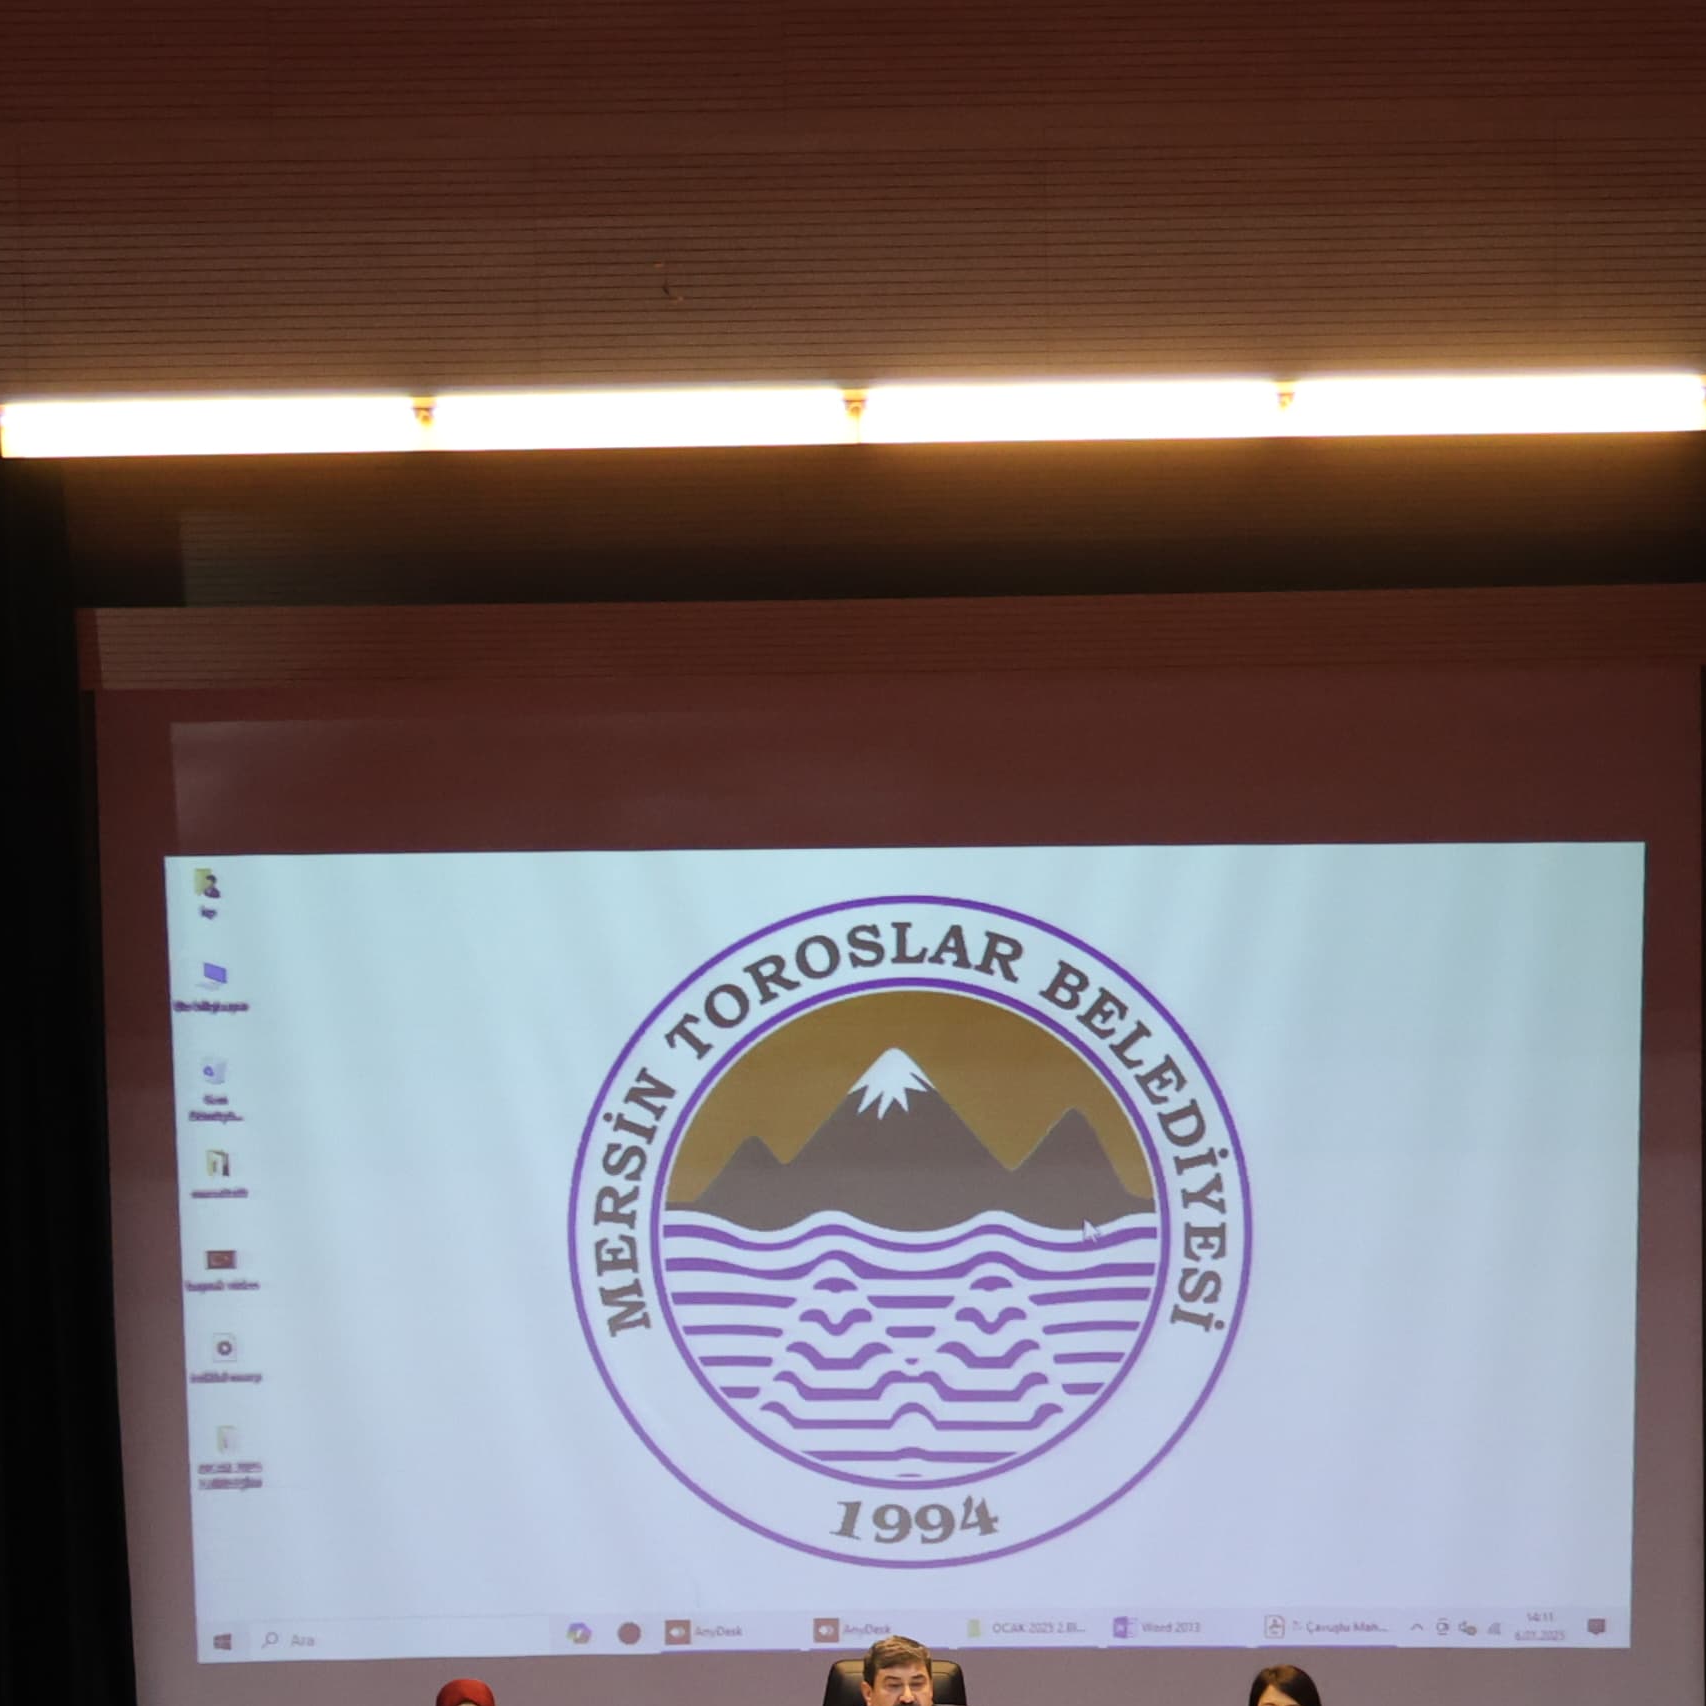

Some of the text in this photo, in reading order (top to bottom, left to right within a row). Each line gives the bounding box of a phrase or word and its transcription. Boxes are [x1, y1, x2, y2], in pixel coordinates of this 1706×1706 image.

[593, 921, 1229, 1337] MERSİN TOROSLAR BELEDİYESİ
[829, 1494, 1000, 1545] 1994
[695, 1625, 743, 1639] AnyDesk
